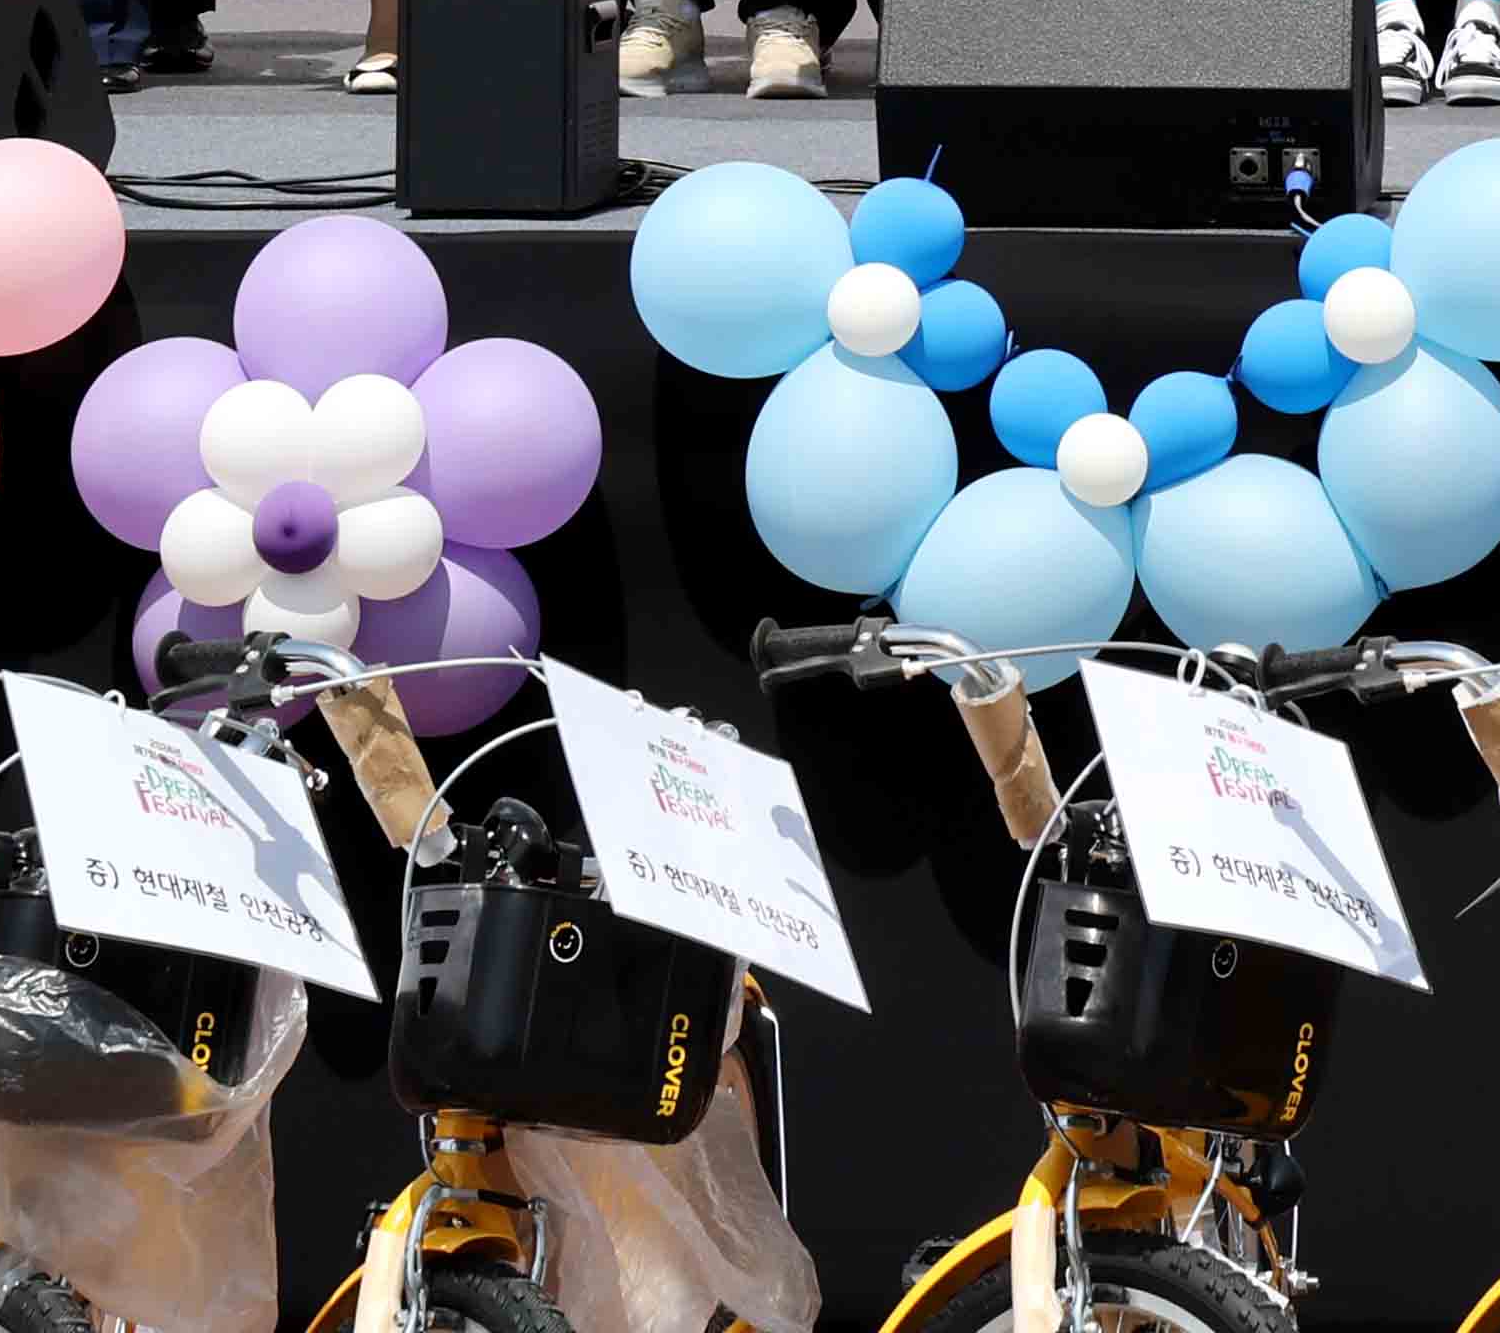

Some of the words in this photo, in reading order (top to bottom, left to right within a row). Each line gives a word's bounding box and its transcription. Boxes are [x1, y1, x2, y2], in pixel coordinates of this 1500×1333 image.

[84, 857, 120, 890] 증)
[133, 865, 228, 914] 현대제철
[240, 893, 325, 943] 인천공장
[626, 848, 657, 883] 증)
[664, 862, 741, 917] 현대제철
[748, 895, 819, 950] 인천공장
[1169, 844, 1202, 877] 증)
[1212, 852, 1298, 901] 현대제철
[1305, 877, 1378, 929] 인천공장
[191, 1011, 216, 1072] CLO
[657, 1012, 690, 1119] CLOVER
[1279, 1022, 1315, 1123] CLOVER
